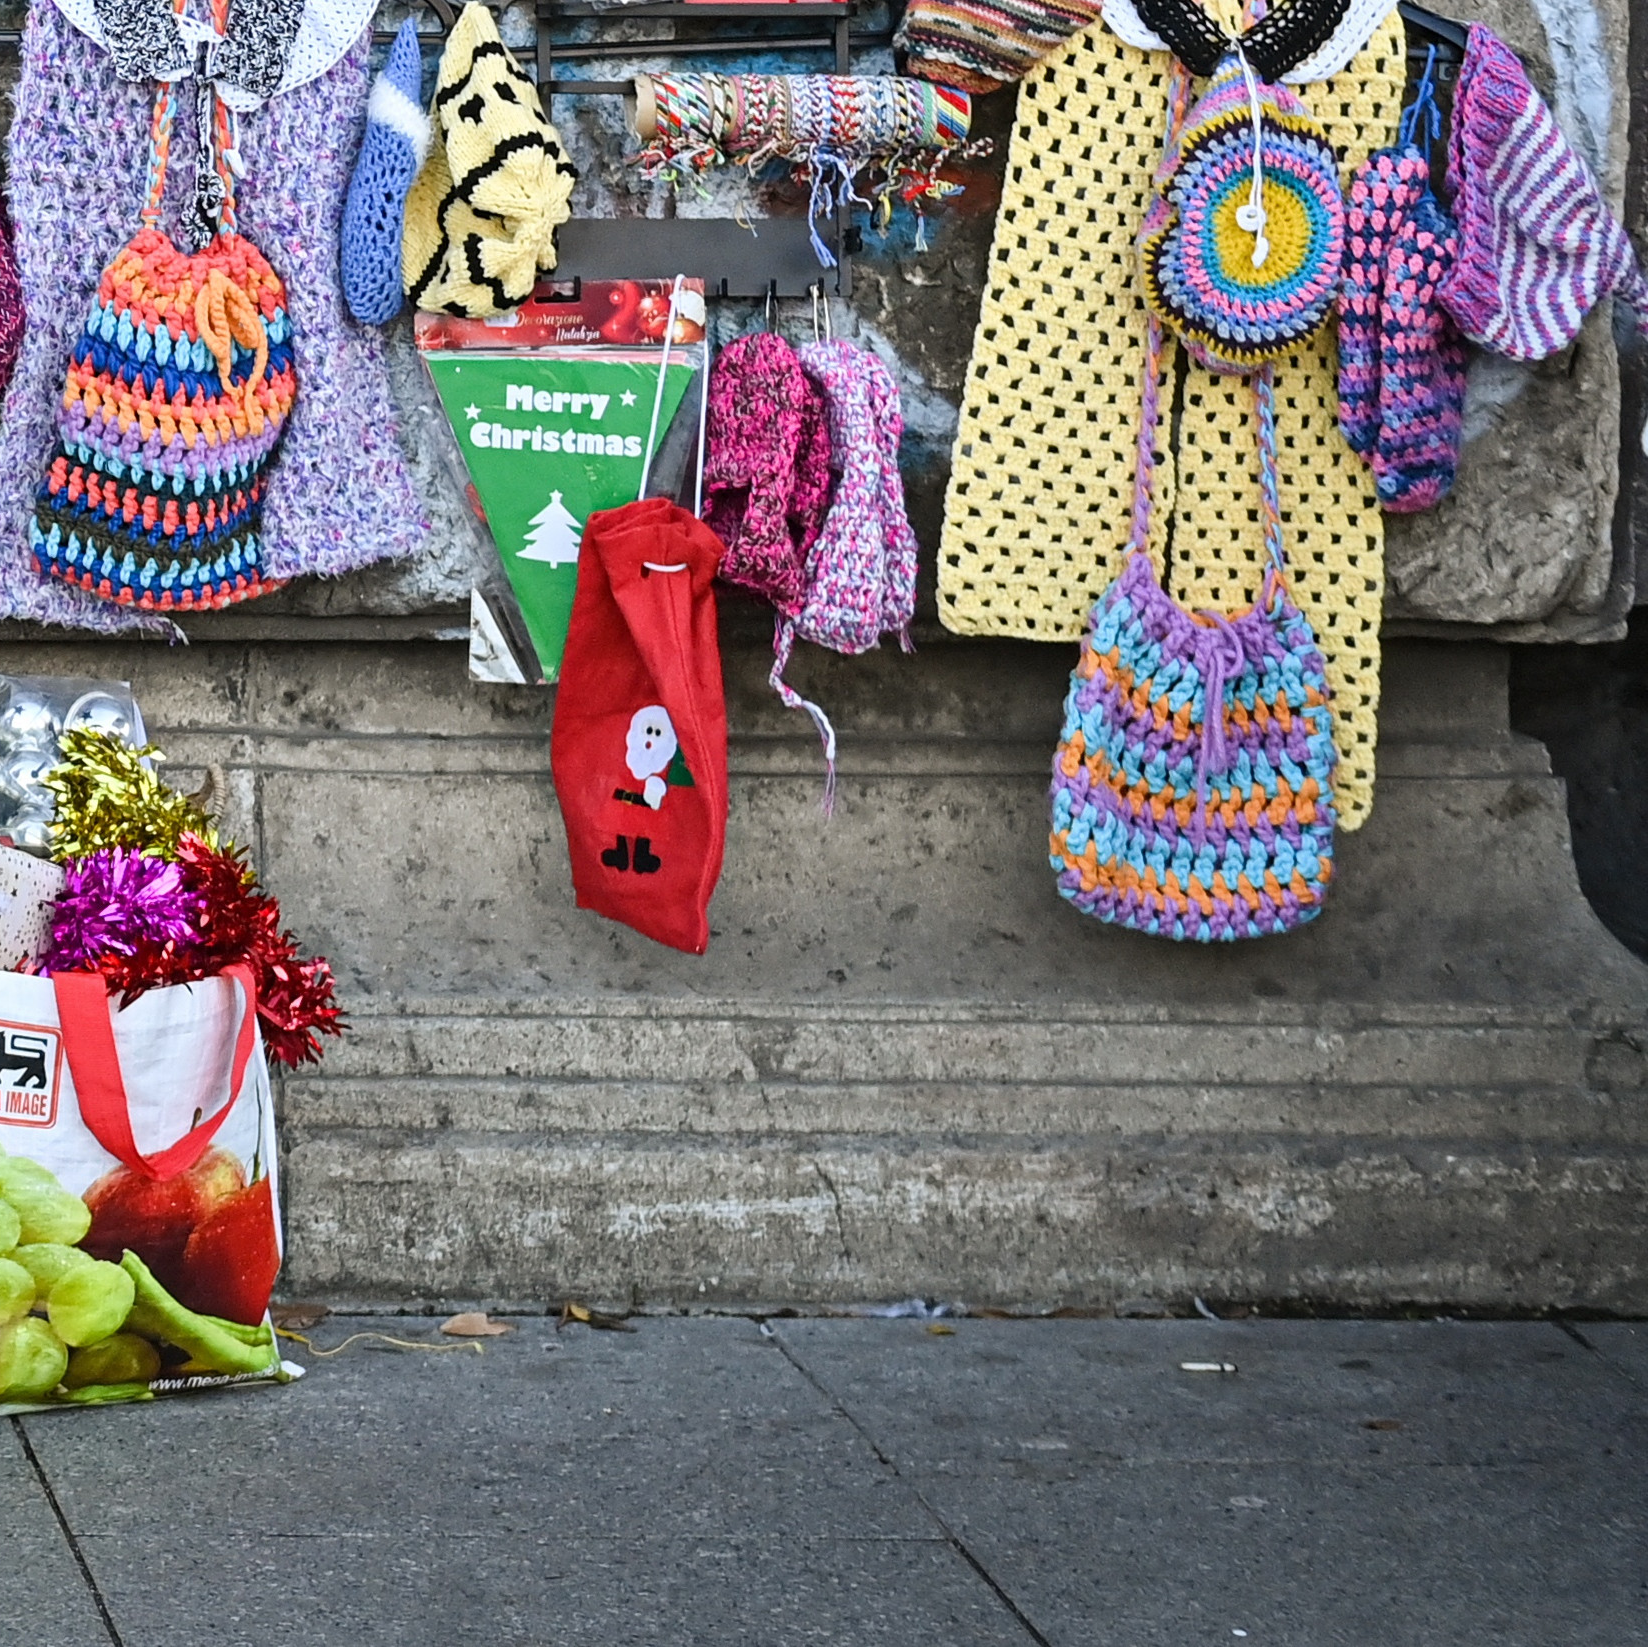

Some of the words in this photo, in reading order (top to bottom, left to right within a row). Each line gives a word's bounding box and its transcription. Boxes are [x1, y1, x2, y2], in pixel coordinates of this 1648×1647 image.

[506, 384, 610, 420] Merry
[470, 422, 642, 457] Christmas
[5, 1091, 48, 1117] IMAGE
